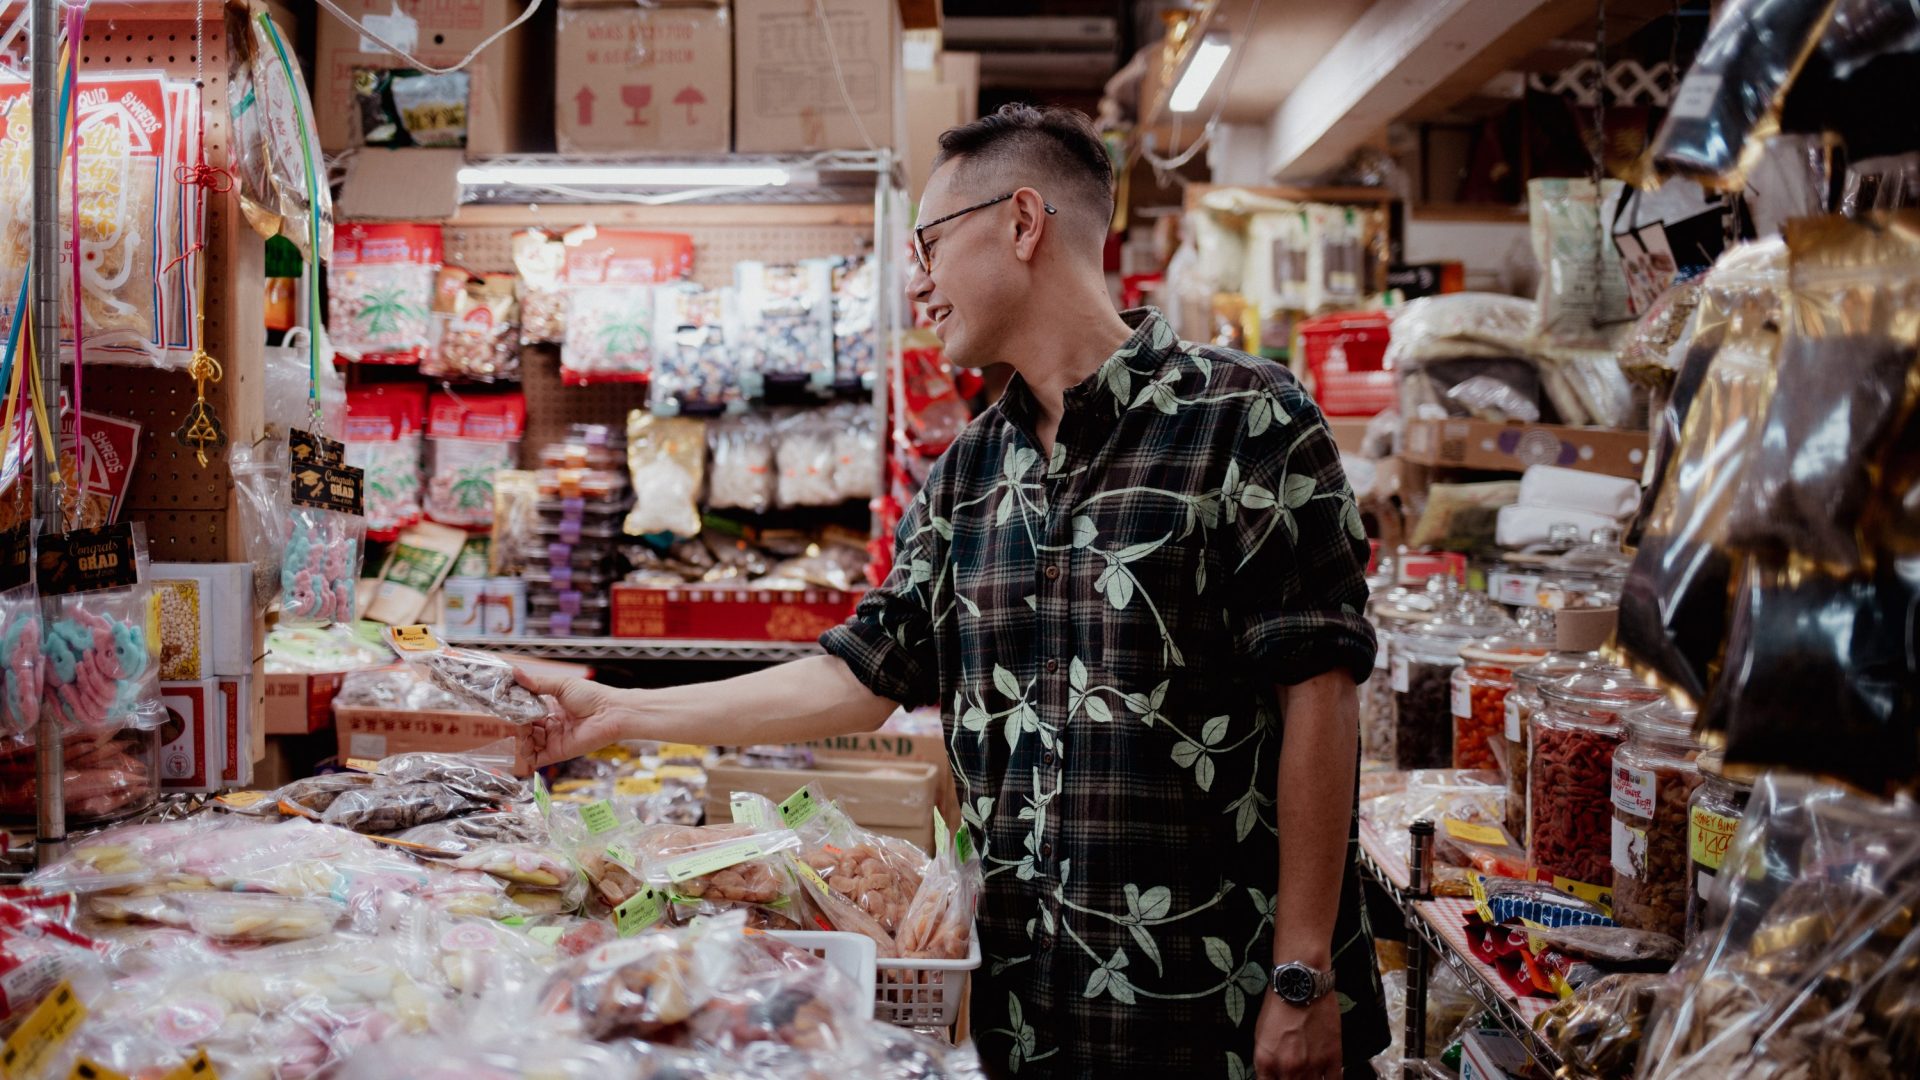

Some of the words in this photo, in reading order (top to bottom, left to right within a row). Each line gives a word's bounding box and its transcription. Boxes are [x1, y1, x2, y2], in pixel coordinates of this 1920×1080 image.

[77, 88, 109, 111] QUID
[121, 91, 162, 134] SHREDS
[91, 431, 124, 473] SHREDS
[70, 540, 118, 557] Congrats
[79, 553, 118, 571] GRAD
